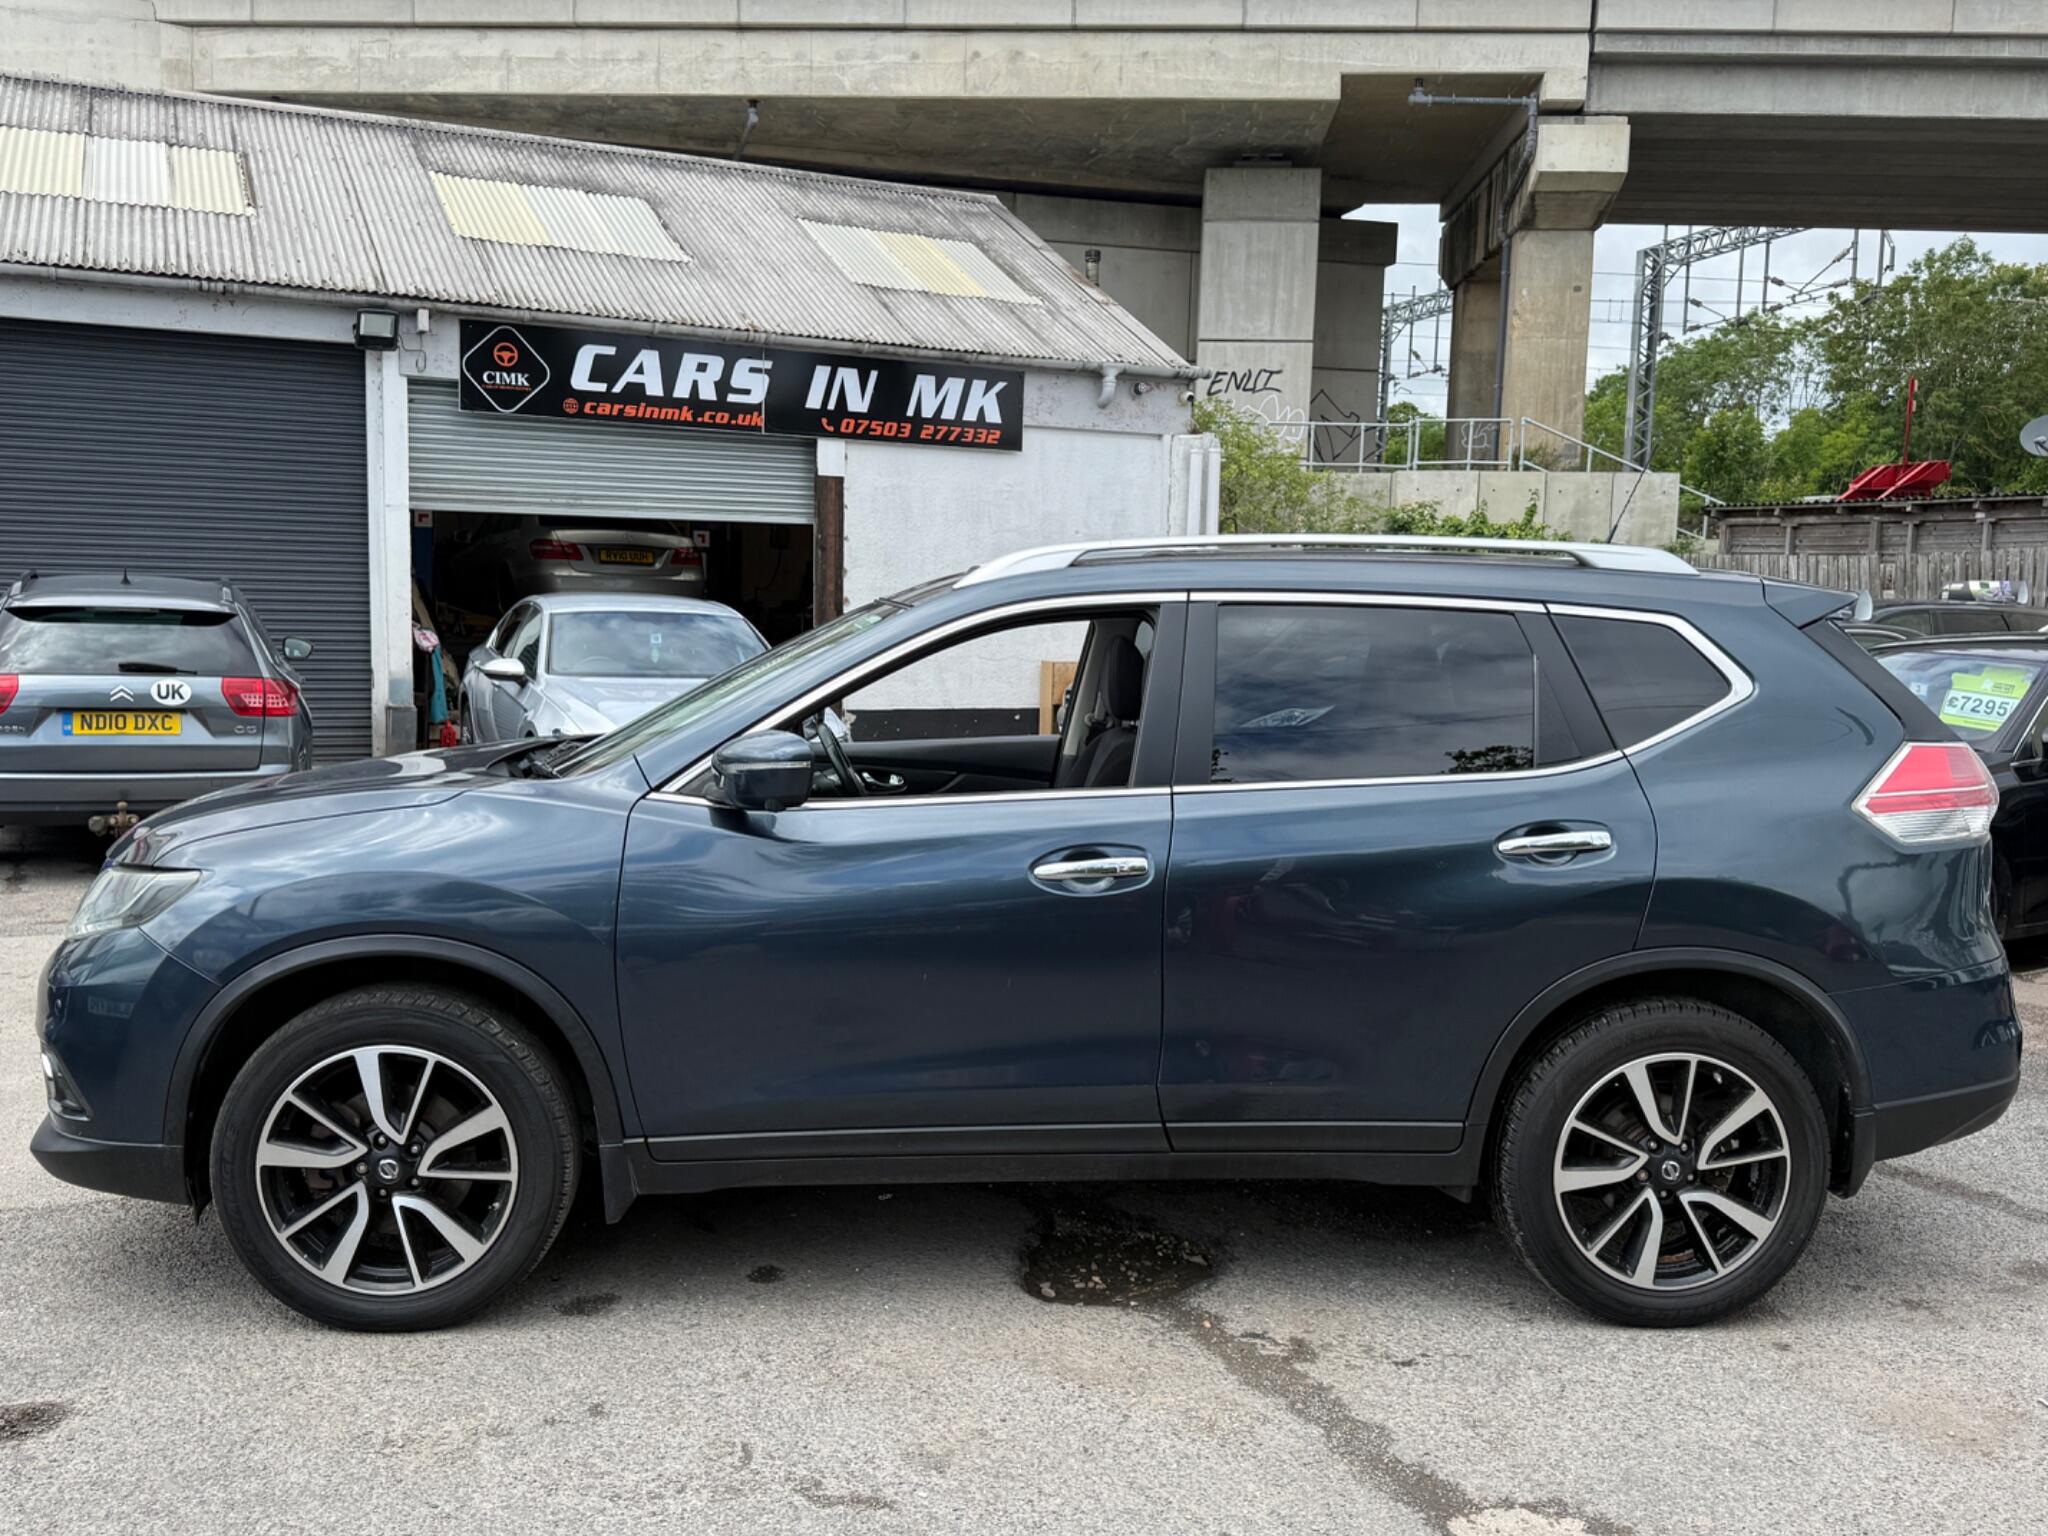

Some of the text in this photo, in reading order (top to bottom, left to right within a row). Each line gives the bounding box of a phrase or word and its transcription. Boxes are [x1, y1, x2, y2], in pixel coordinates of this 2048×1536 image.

[482, 370, 530, 387] CIMK
[570, 344, 1008, 424] CARS IN MK
[584, 402, 764, 427] carsinmk.co.uk
[840, 418, 1002, 444] 07503 277332
[156, 684, 185, 701] UK
[1947, 695, 2010, 717] £7295
[80, 713, 173, 731] ND10 DXC
